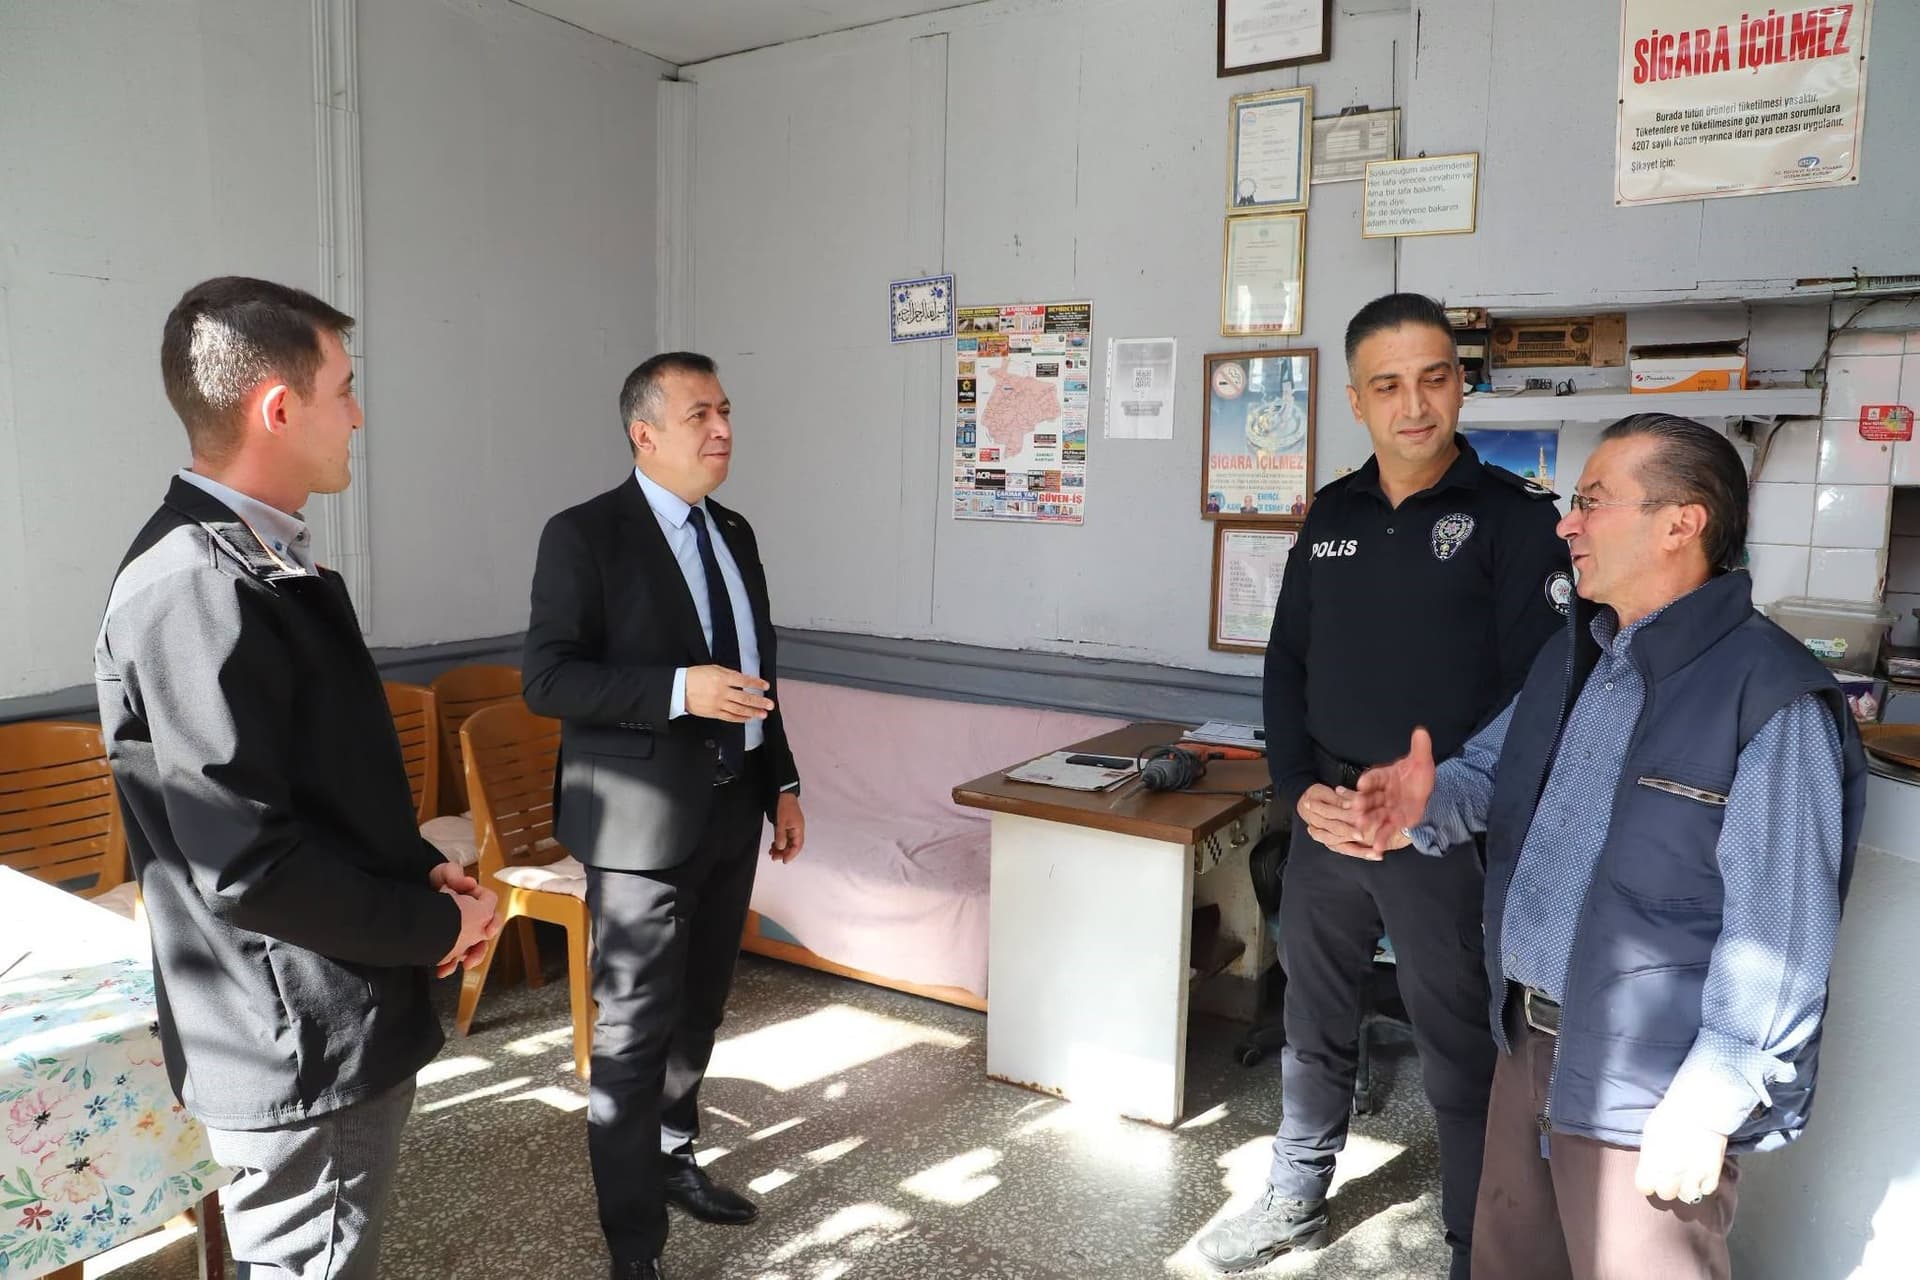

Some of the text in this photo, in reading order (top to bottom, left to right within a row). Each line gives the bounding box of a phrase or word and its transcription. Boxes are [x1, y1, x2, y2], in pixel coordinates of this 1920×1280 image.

[1633, 4, 1853, 84] SİGARA İÇİLMEZ
[1635, 104, 1840, 137] Tüketenlere ve tüketilmesine göz yuman sorumlulara
[1656, 110, 1682, 122] Burada
[1685, 109, 1704, 119] tütün
[1706, 103, 1737, 117] ürünleri
[1738, 96, 1782, 111] tüketilmesi
[1632, 140, 1650, 151] 4207
[1652, 138, 1672, 150] sayılı
[1673, 136, 1698, 146] Kanun
[1699, 131, 1733, 144] uyarınca
[1754, 127, 1773, 139] para
[1775, 123, 1801, 133] cezası
[1631, 159, 1658, 173] Şikayet
[1378, 208, 1389, 217] de
